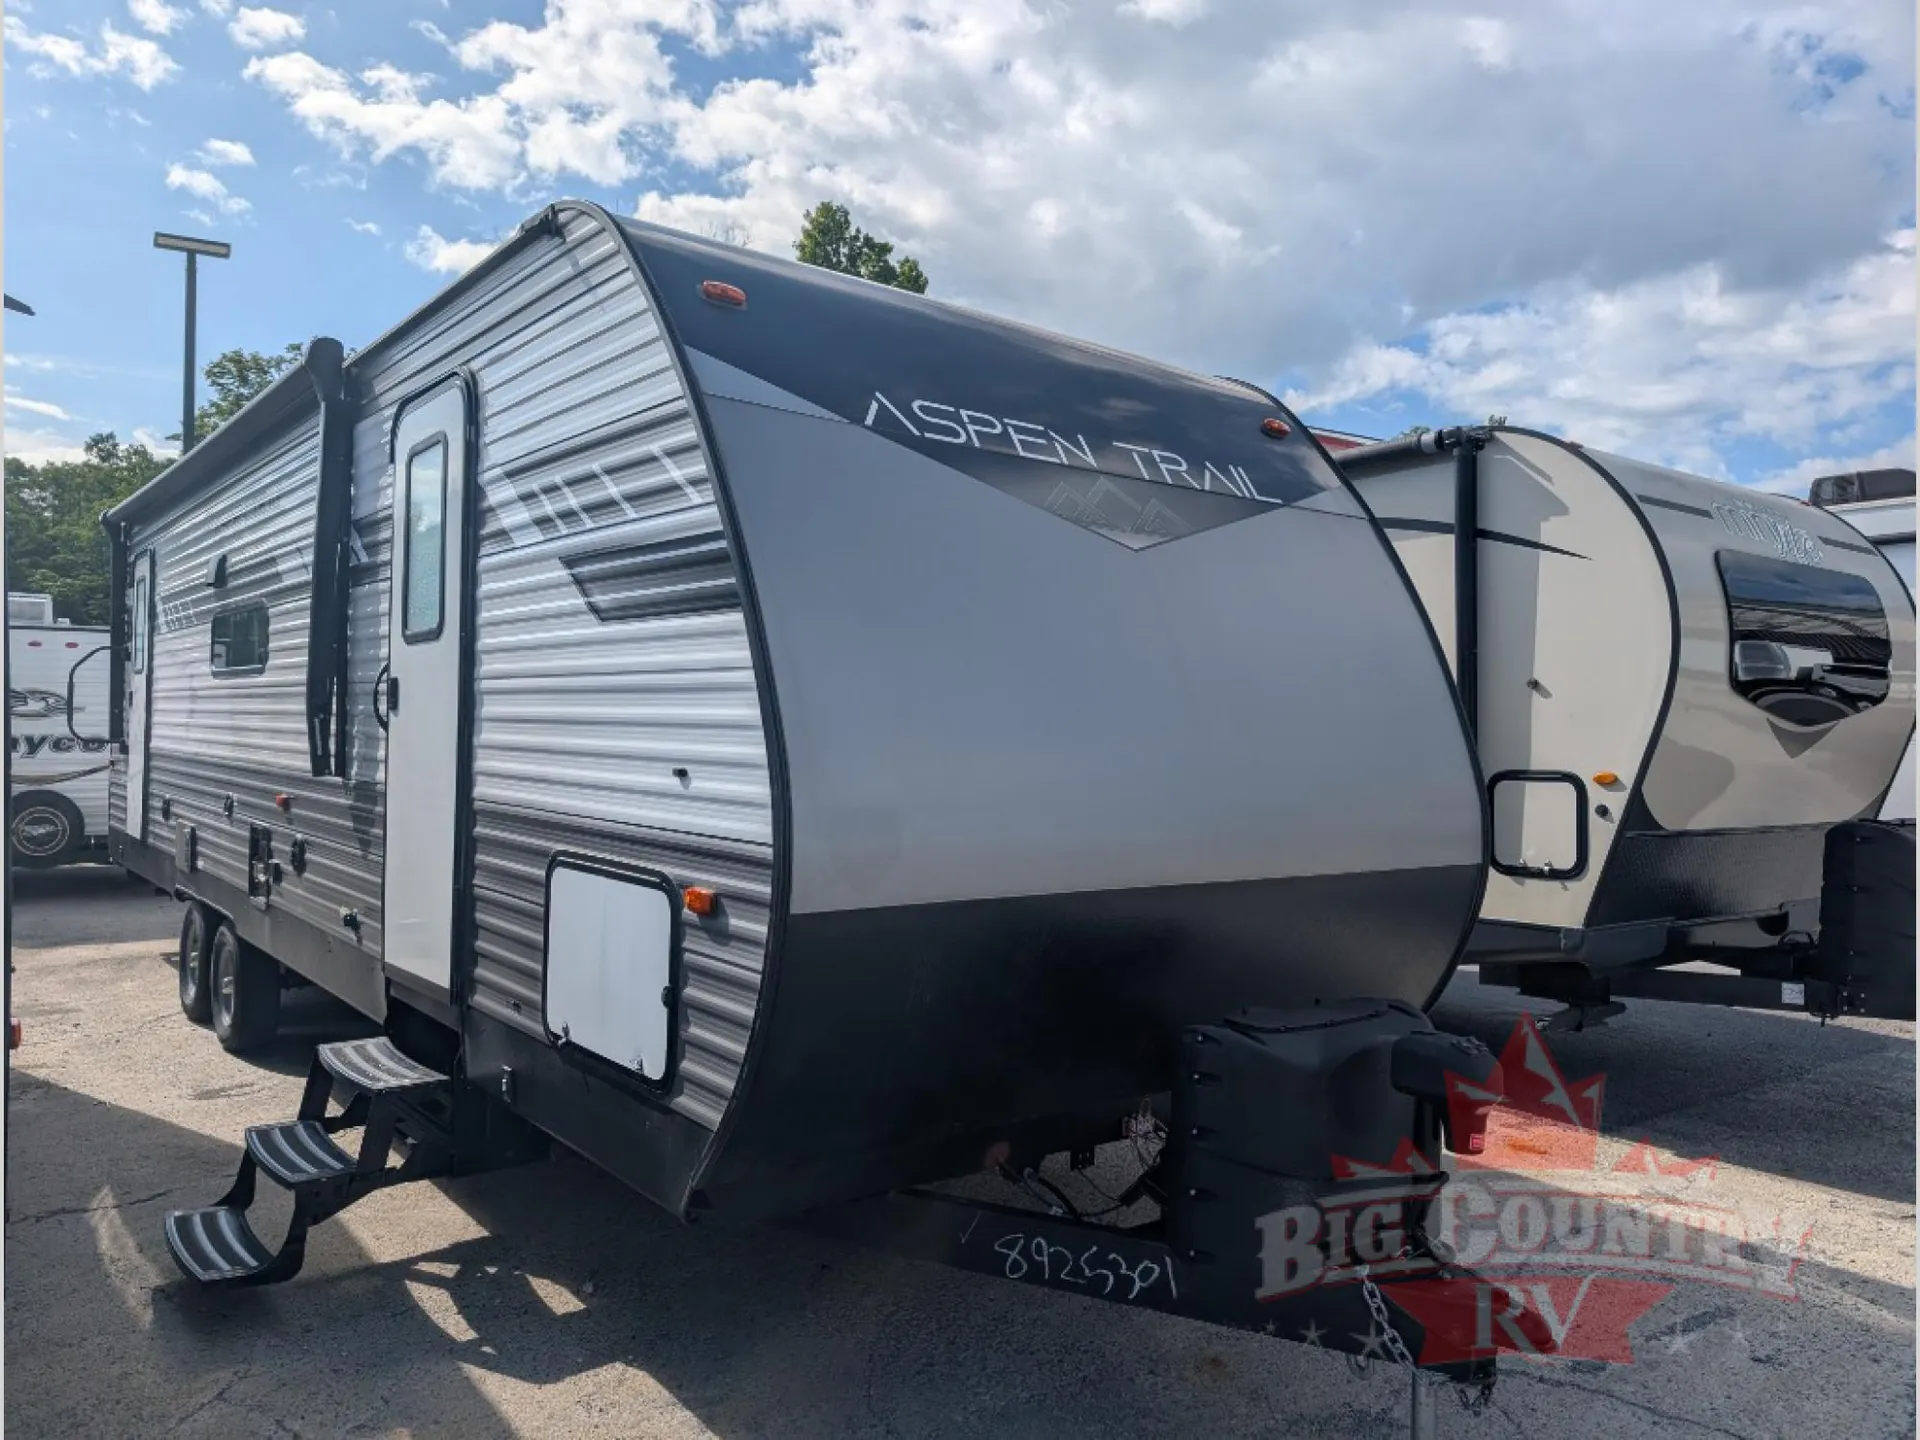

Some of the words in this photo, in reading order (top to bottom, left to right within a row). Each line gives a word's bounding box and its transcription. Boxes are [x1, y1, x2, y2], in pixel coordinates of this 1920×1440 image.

[865, 391, 1098, 468] ASPEN
[1112, 441, 1283, 503] TRAIL
[994, 1234, 1178, 1300] 8925301
